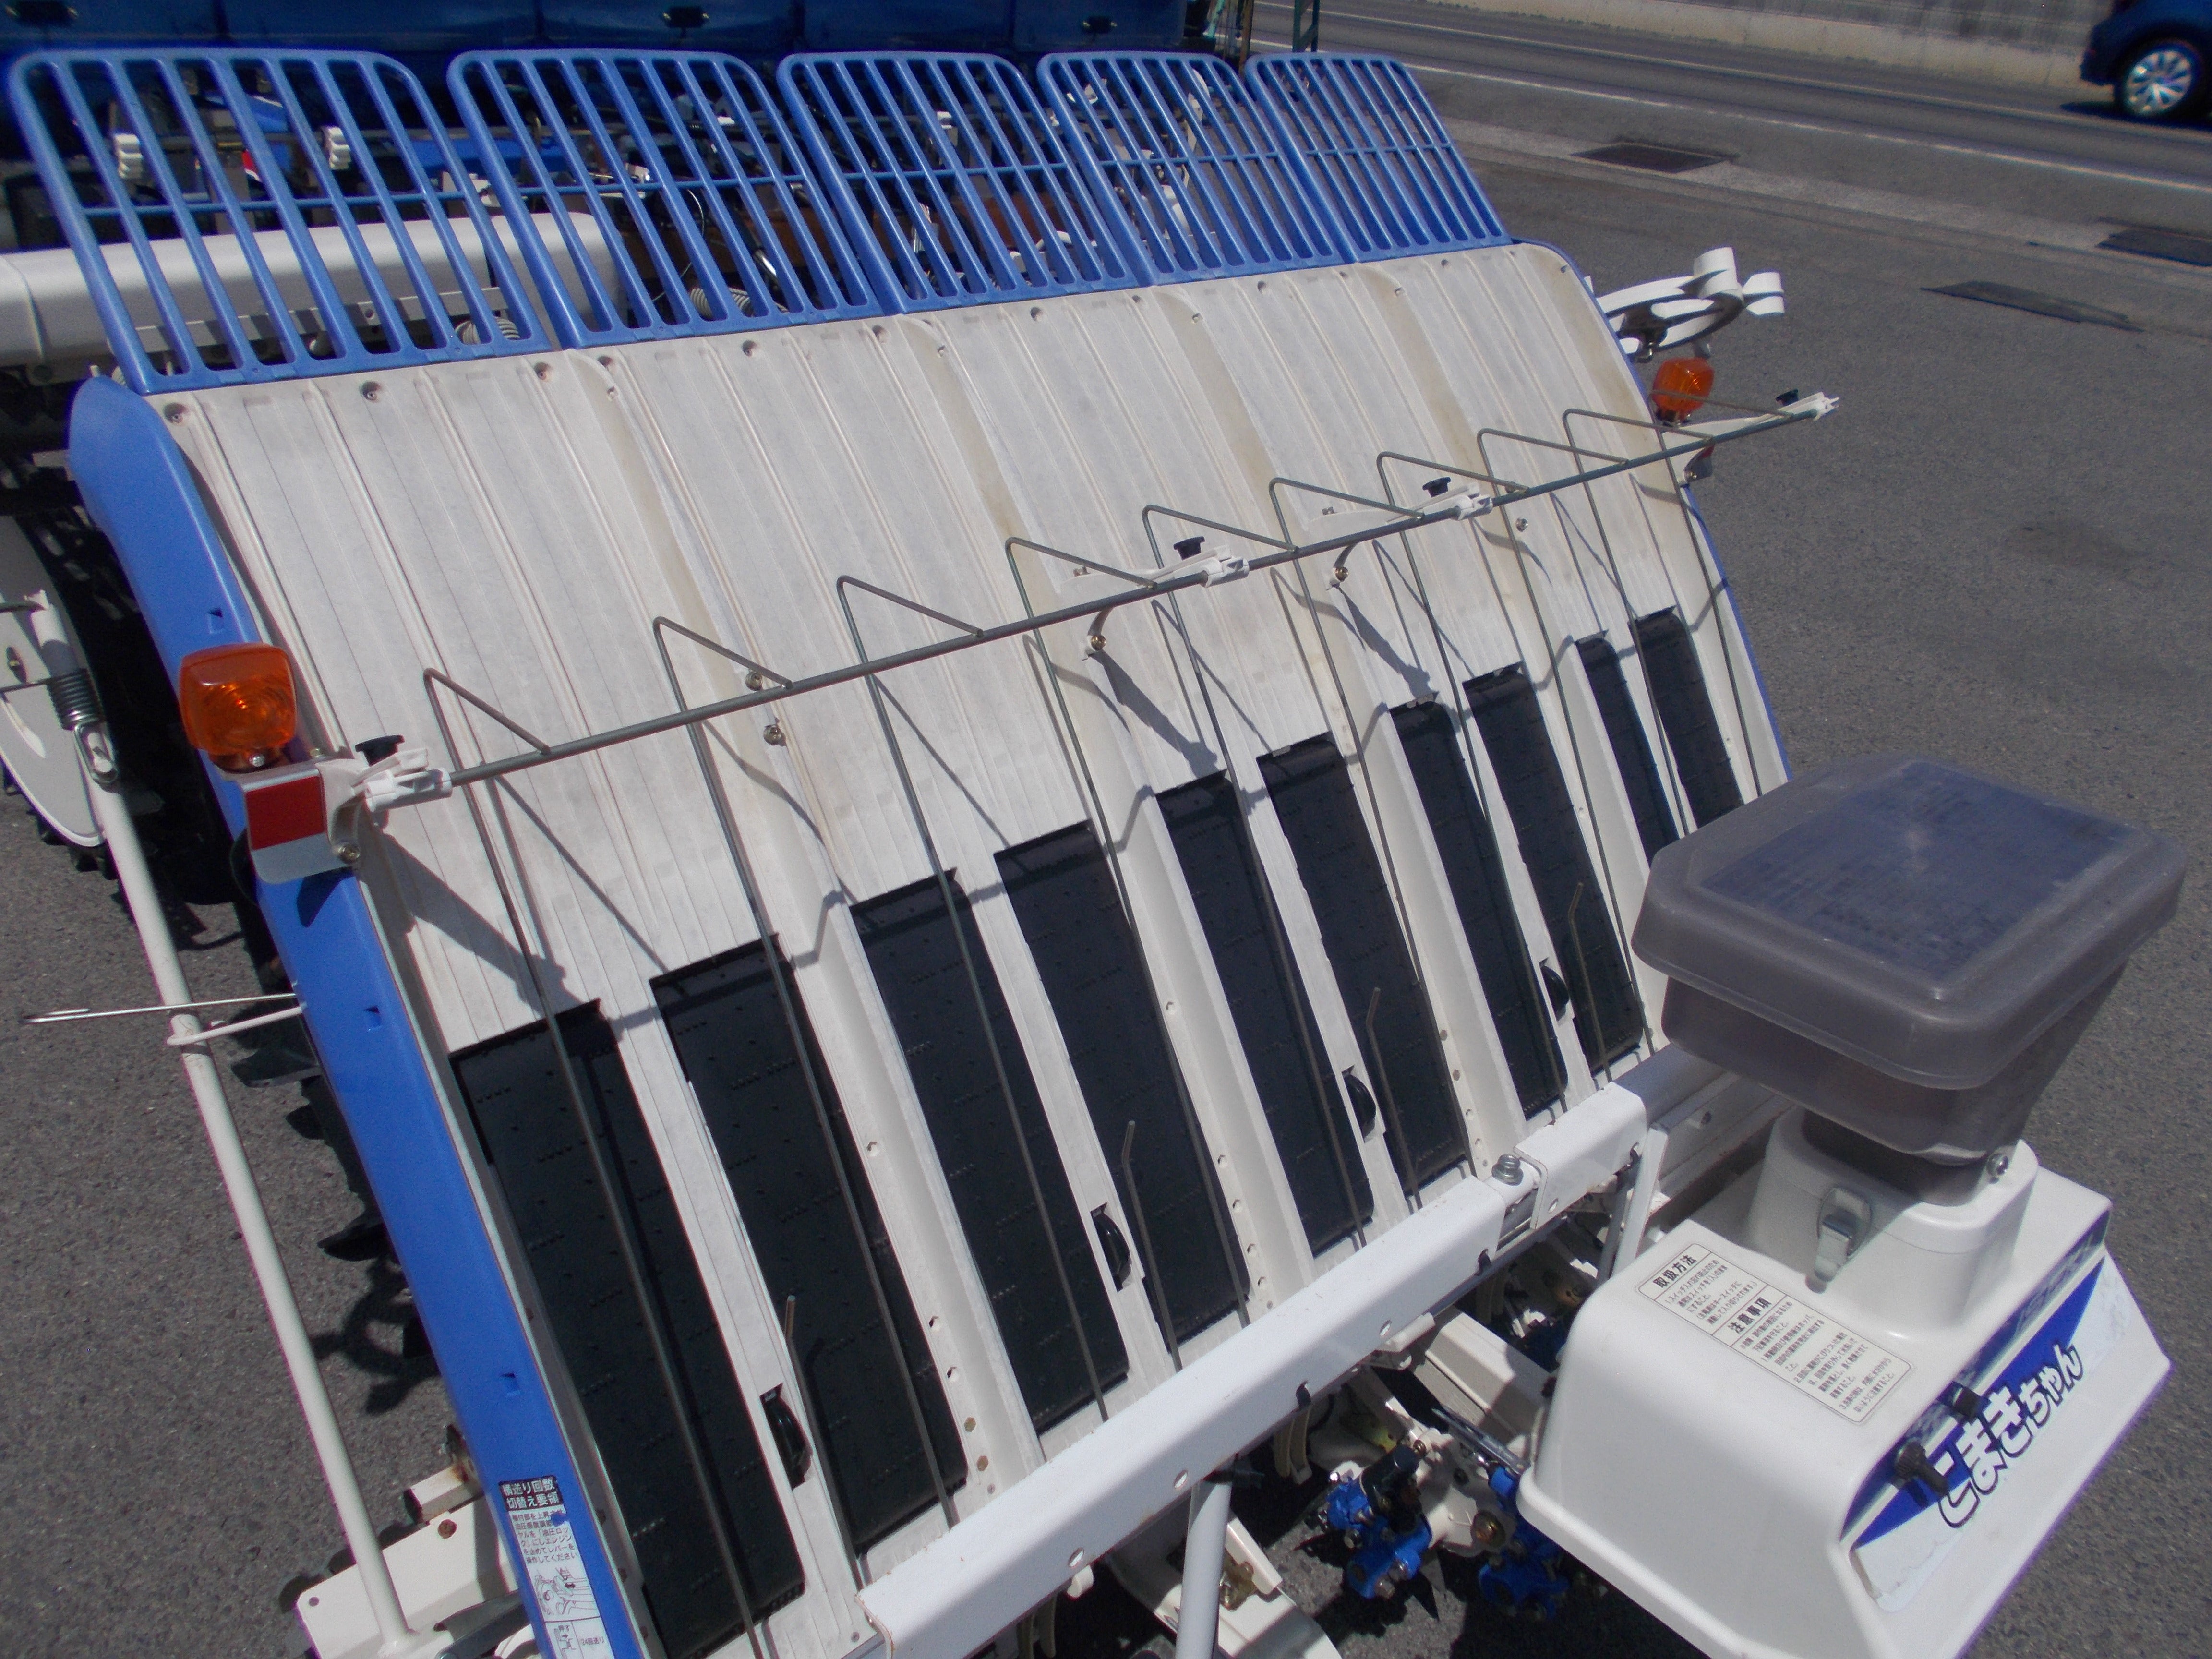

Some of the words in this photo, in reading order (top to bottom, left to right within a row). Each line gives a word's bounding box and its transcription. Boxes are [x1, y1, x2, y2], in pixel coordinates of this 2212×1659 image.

[1651, 1254, 1698, 1288] 取扱方法
[1685, 1292, 1712, 1313] にすること。
[1726, 1297, 1772, 1334] 注意事項
[1784, 1360, 1799, 1372] こと。
[1936, 1339, 2084, 1528] こまきちゃん
[502, 1478, 555, 1495] 横送り回数
[506, 1492, 559, 1509] 切替え要領
[512, 1509, 563, 1522] 植付部を上昇
[524, 1544, 575, 1554] を止めてレバーを
[527, 1553, 577, 1564] 操作してください
